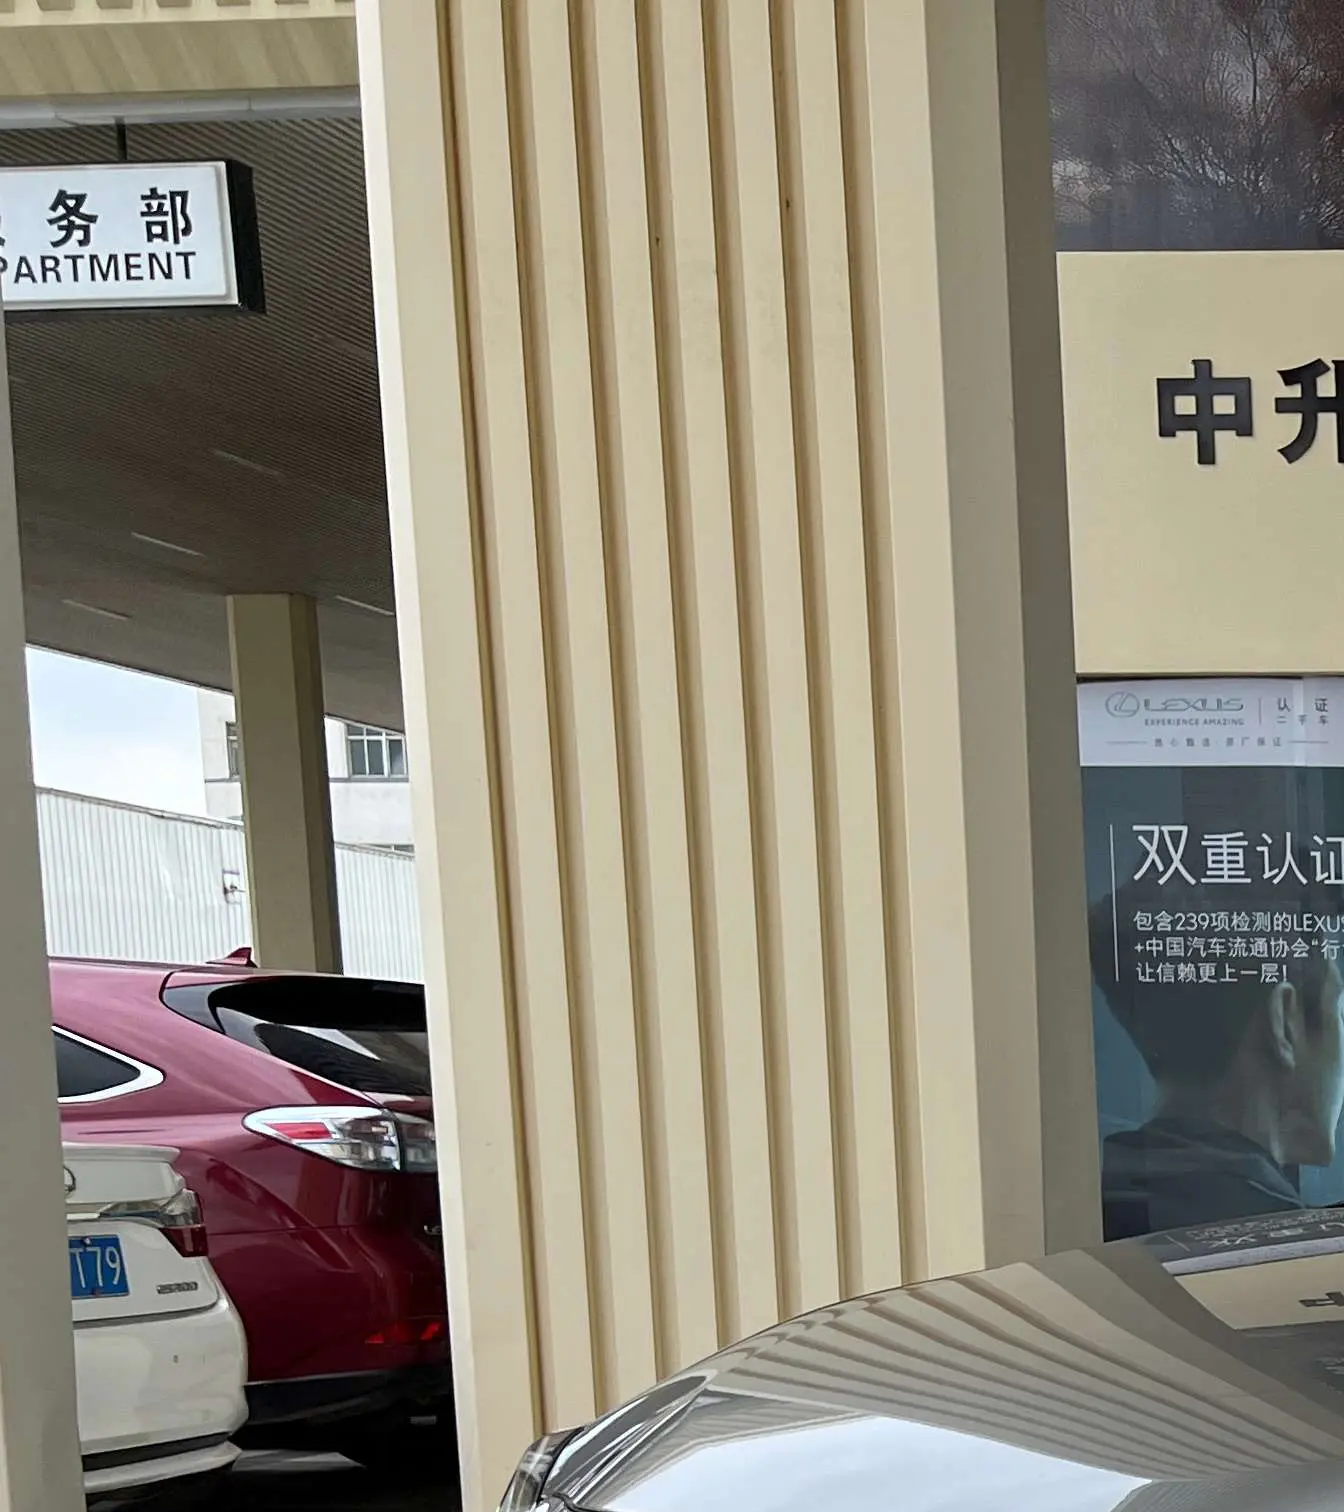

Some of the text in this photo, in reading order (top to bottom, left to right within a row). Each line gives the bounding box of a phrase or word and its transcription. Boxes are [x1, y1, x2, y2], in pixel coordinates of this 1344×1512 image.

[0, 187, 192, 248] 务部
[1144, 698, 1244, 712] LEXUS
[1276, 697, 1329, 713] 认证
